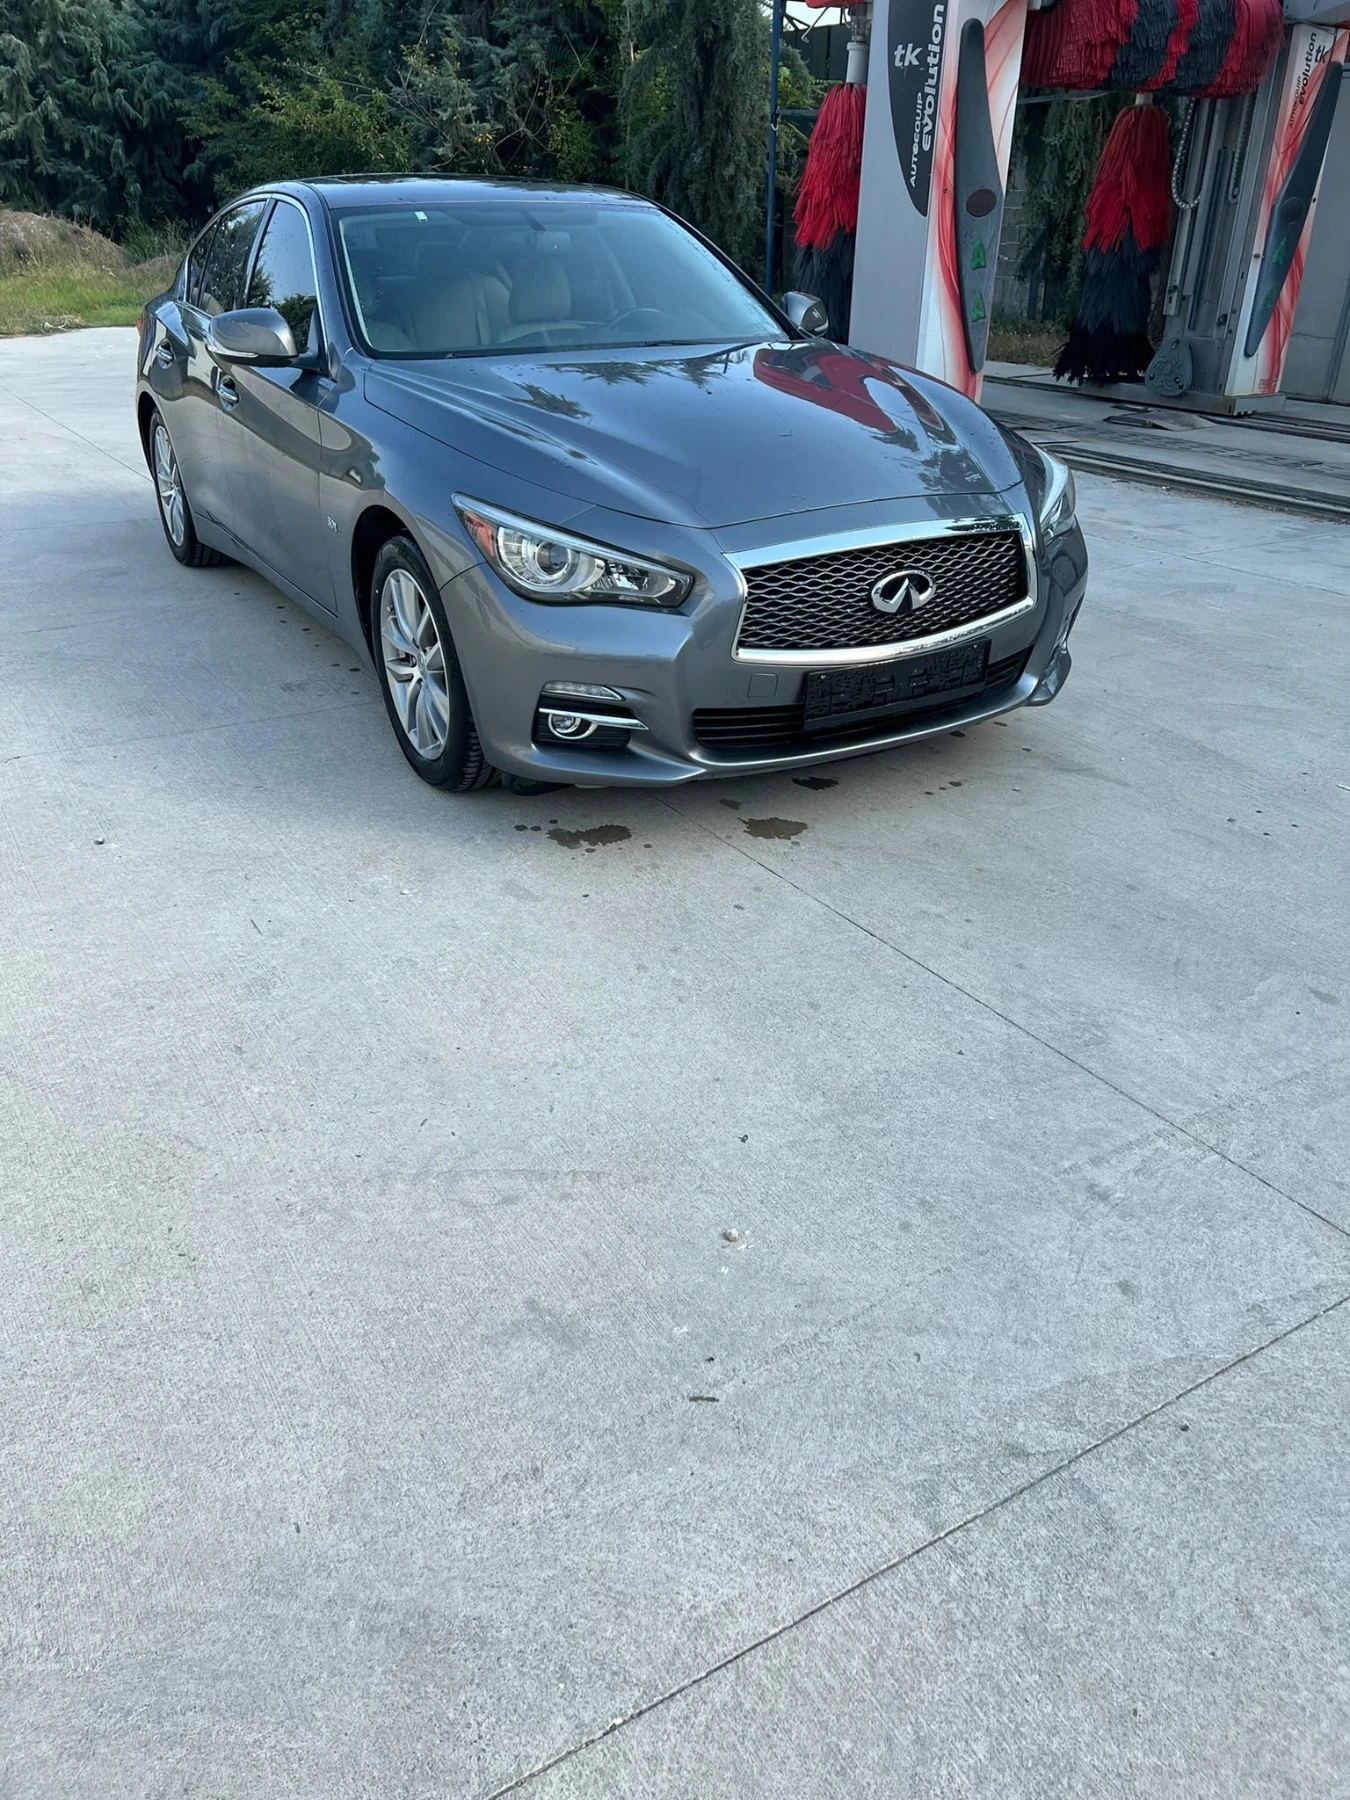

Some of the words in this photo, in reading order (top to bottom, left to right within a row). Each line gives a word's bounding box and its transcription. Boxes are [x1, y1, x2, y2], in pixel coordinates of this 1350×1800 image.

[894, 43, 923, 67] tk
[922, 4, 945, 152] evolution
[1299, 32, 1317, 105] evolution
[1314, 45, 1330, 64] tk
[909, 92, 923, 188] AUTOEQUIP
